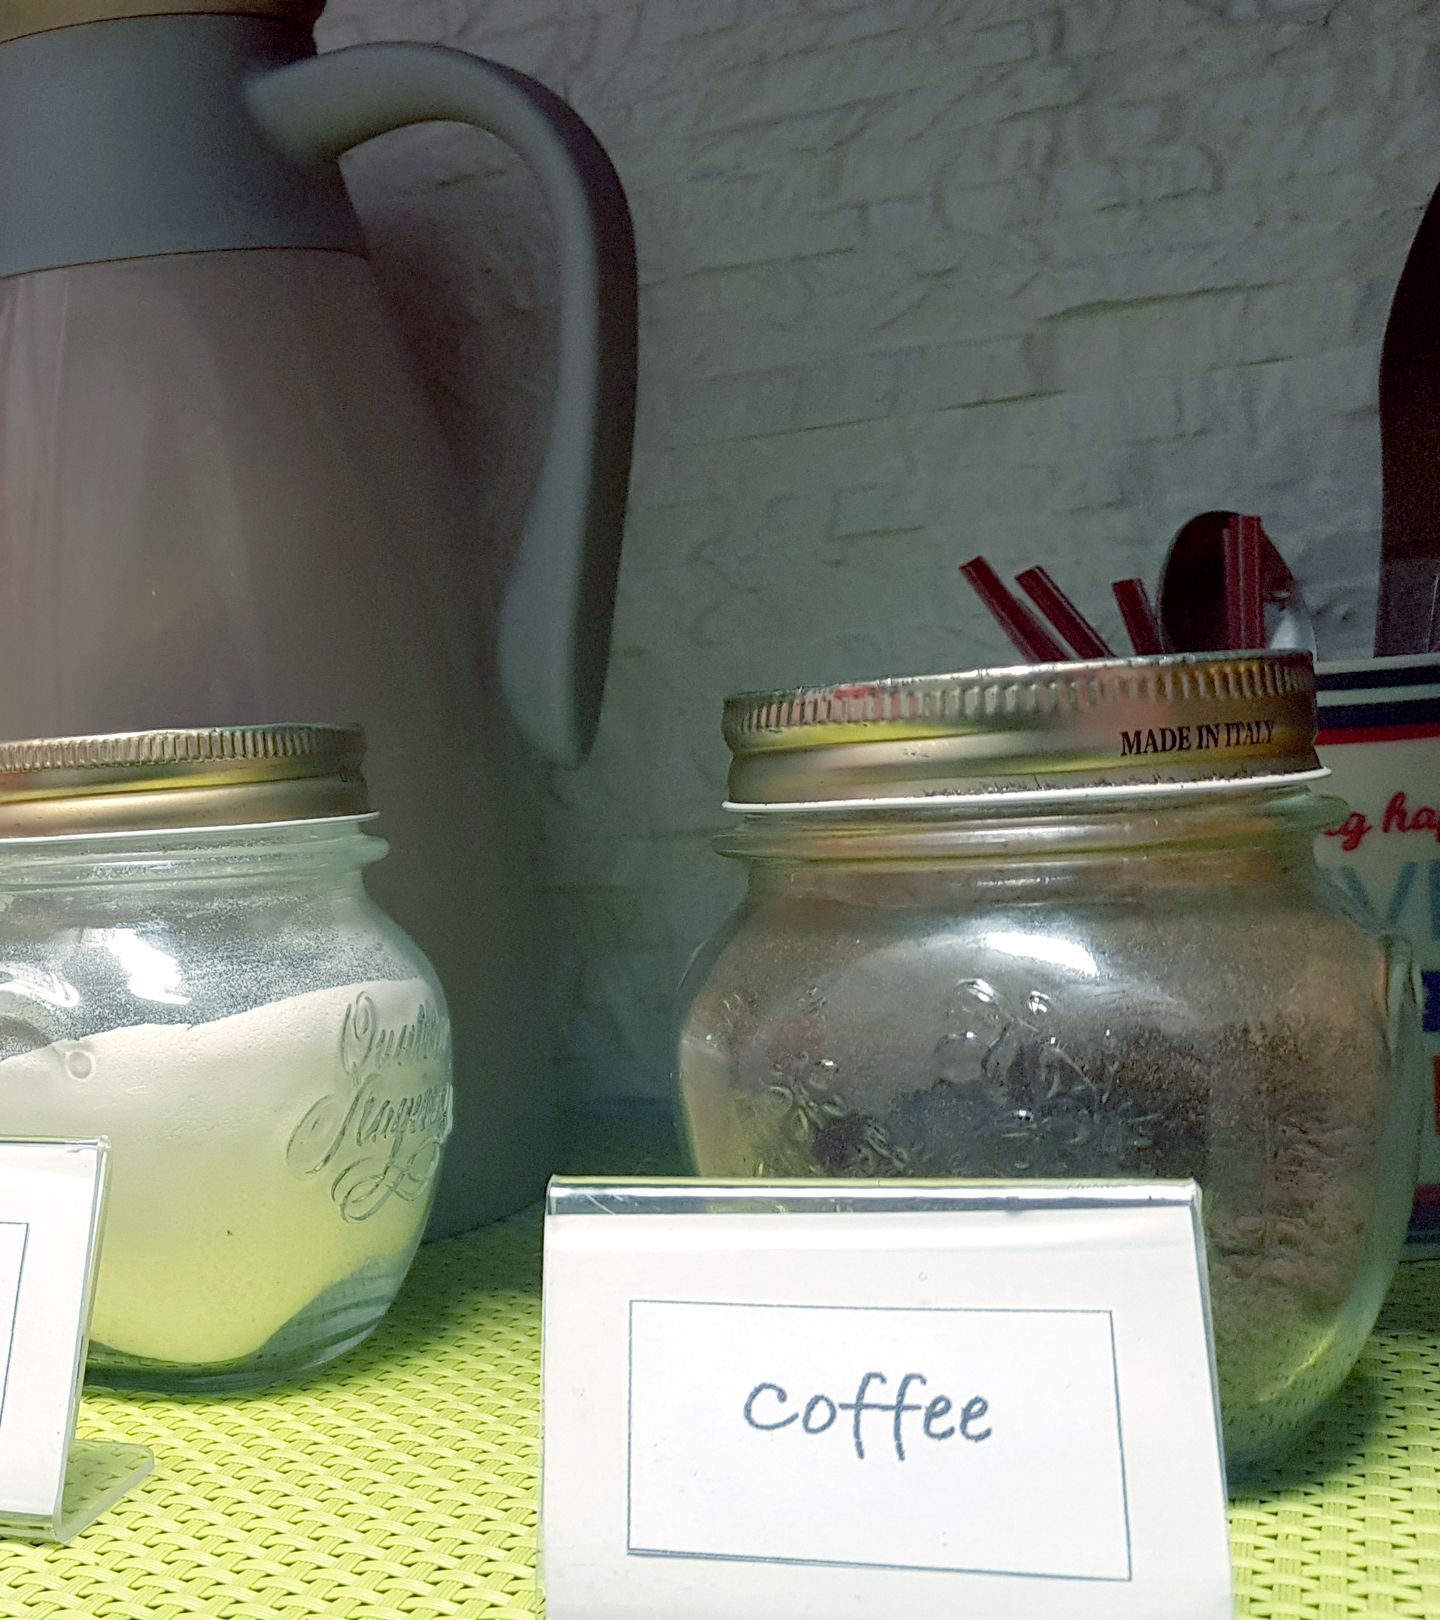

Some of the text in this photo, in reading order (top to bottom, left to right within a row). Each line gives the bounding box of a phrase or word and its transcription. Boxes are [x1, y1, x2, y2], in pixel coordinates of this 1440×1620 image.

[1120, 720, 1274, 756] MADE IN ITALY
[743, 1371, 992, 1461] Coffee
